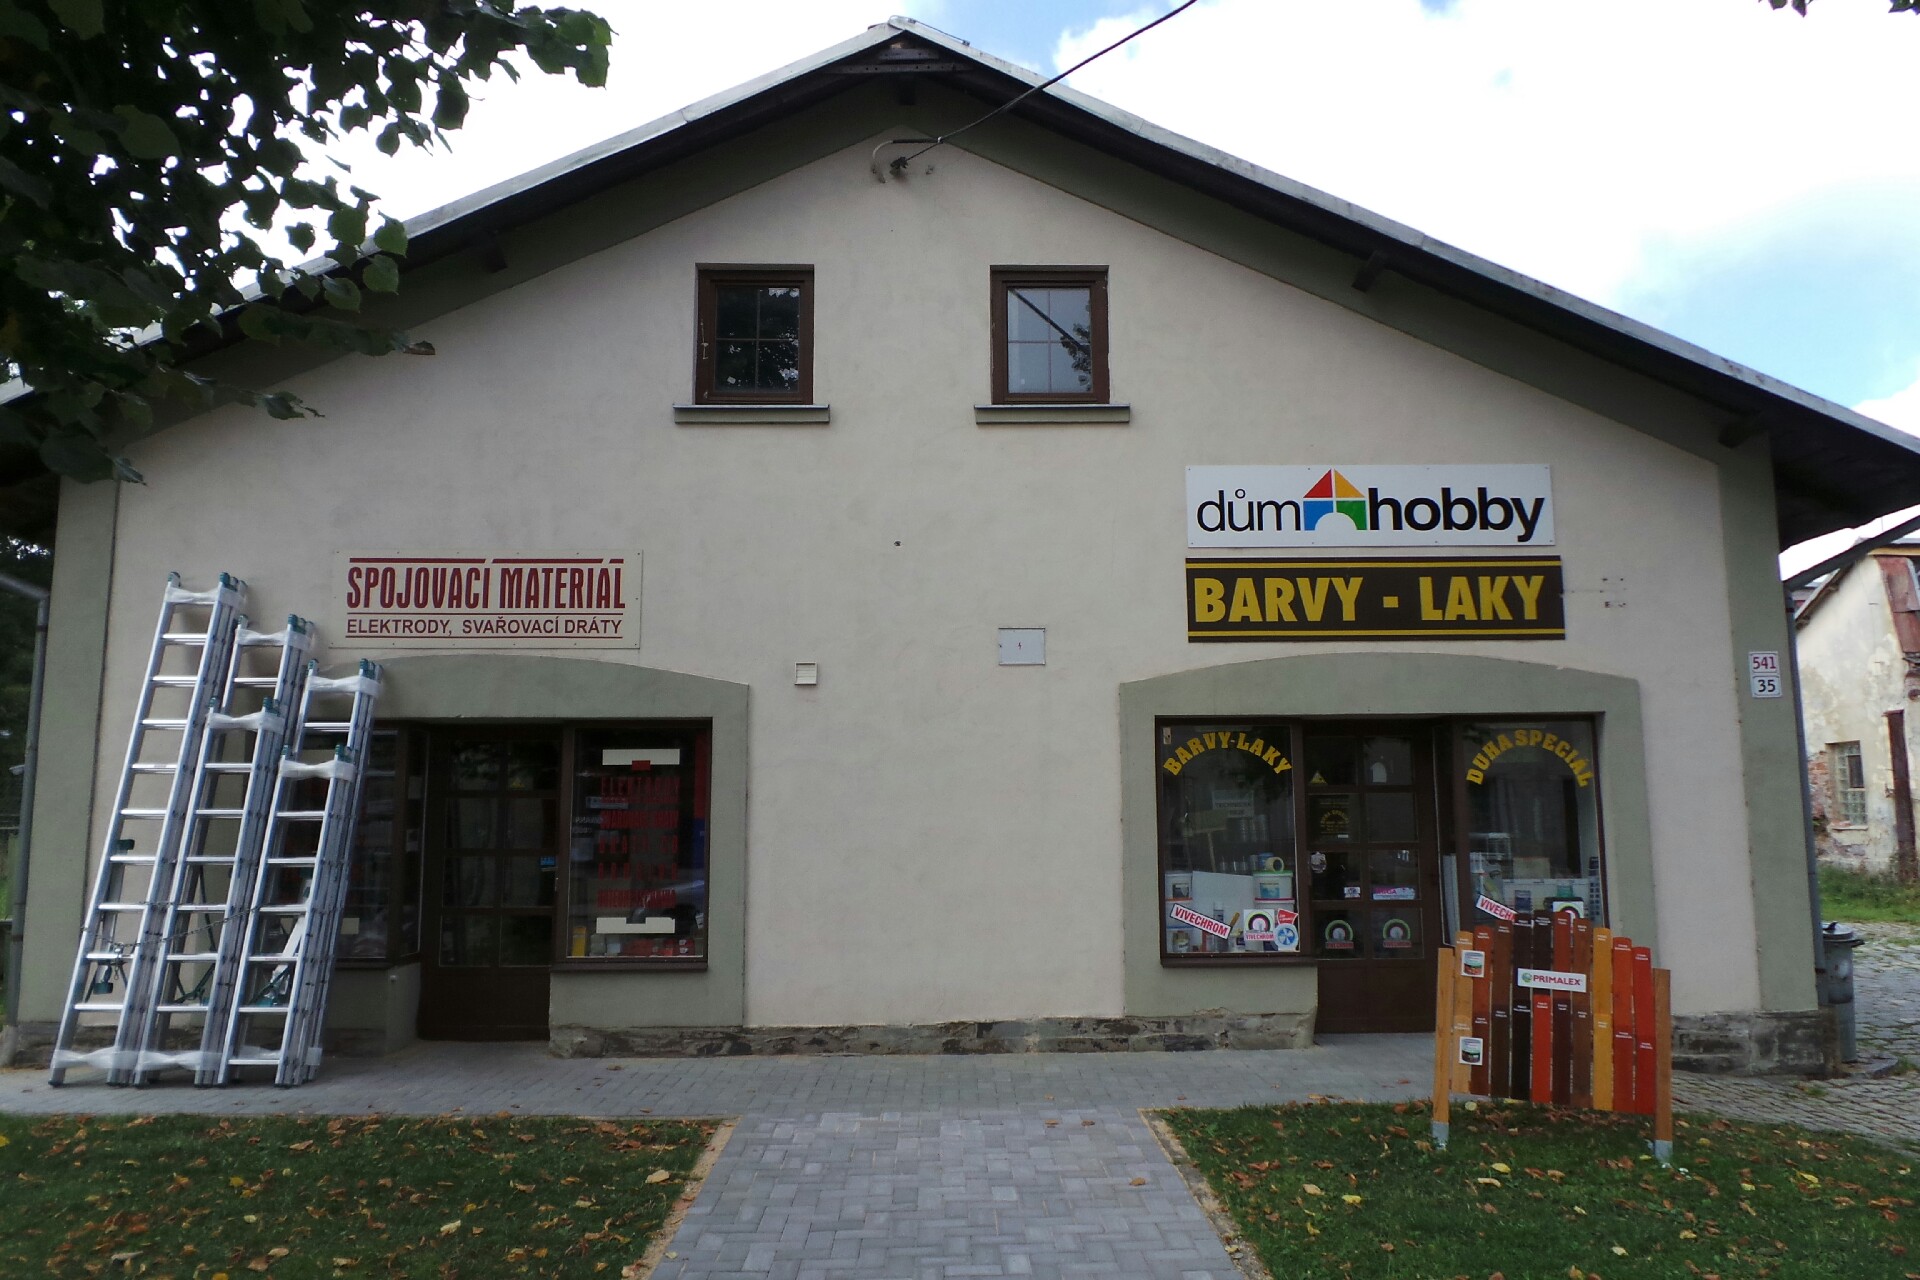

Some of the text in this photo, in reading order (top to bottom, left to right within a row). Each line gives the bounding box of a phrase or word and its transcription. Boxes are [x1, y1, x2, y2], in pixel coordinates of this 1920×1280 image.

[1196, 487, 1545, 543] dům hobby
[1194, 577, 1364, 623] BARVY
[1418, 575, 1545, 621] LAKY
[347, 616, 622, 636] ELEKTRODY, SVAŘOVACÍ DRÁTY
[1752, 656, 1776, 670] 541
[1757, 679, 1776, 693] 35
[1466, 734, 1514, 785] DUHA
[1174, 906, 1229, 937] VIVECHROM
[1533, 974, 1581, 986] PRIMALEX
